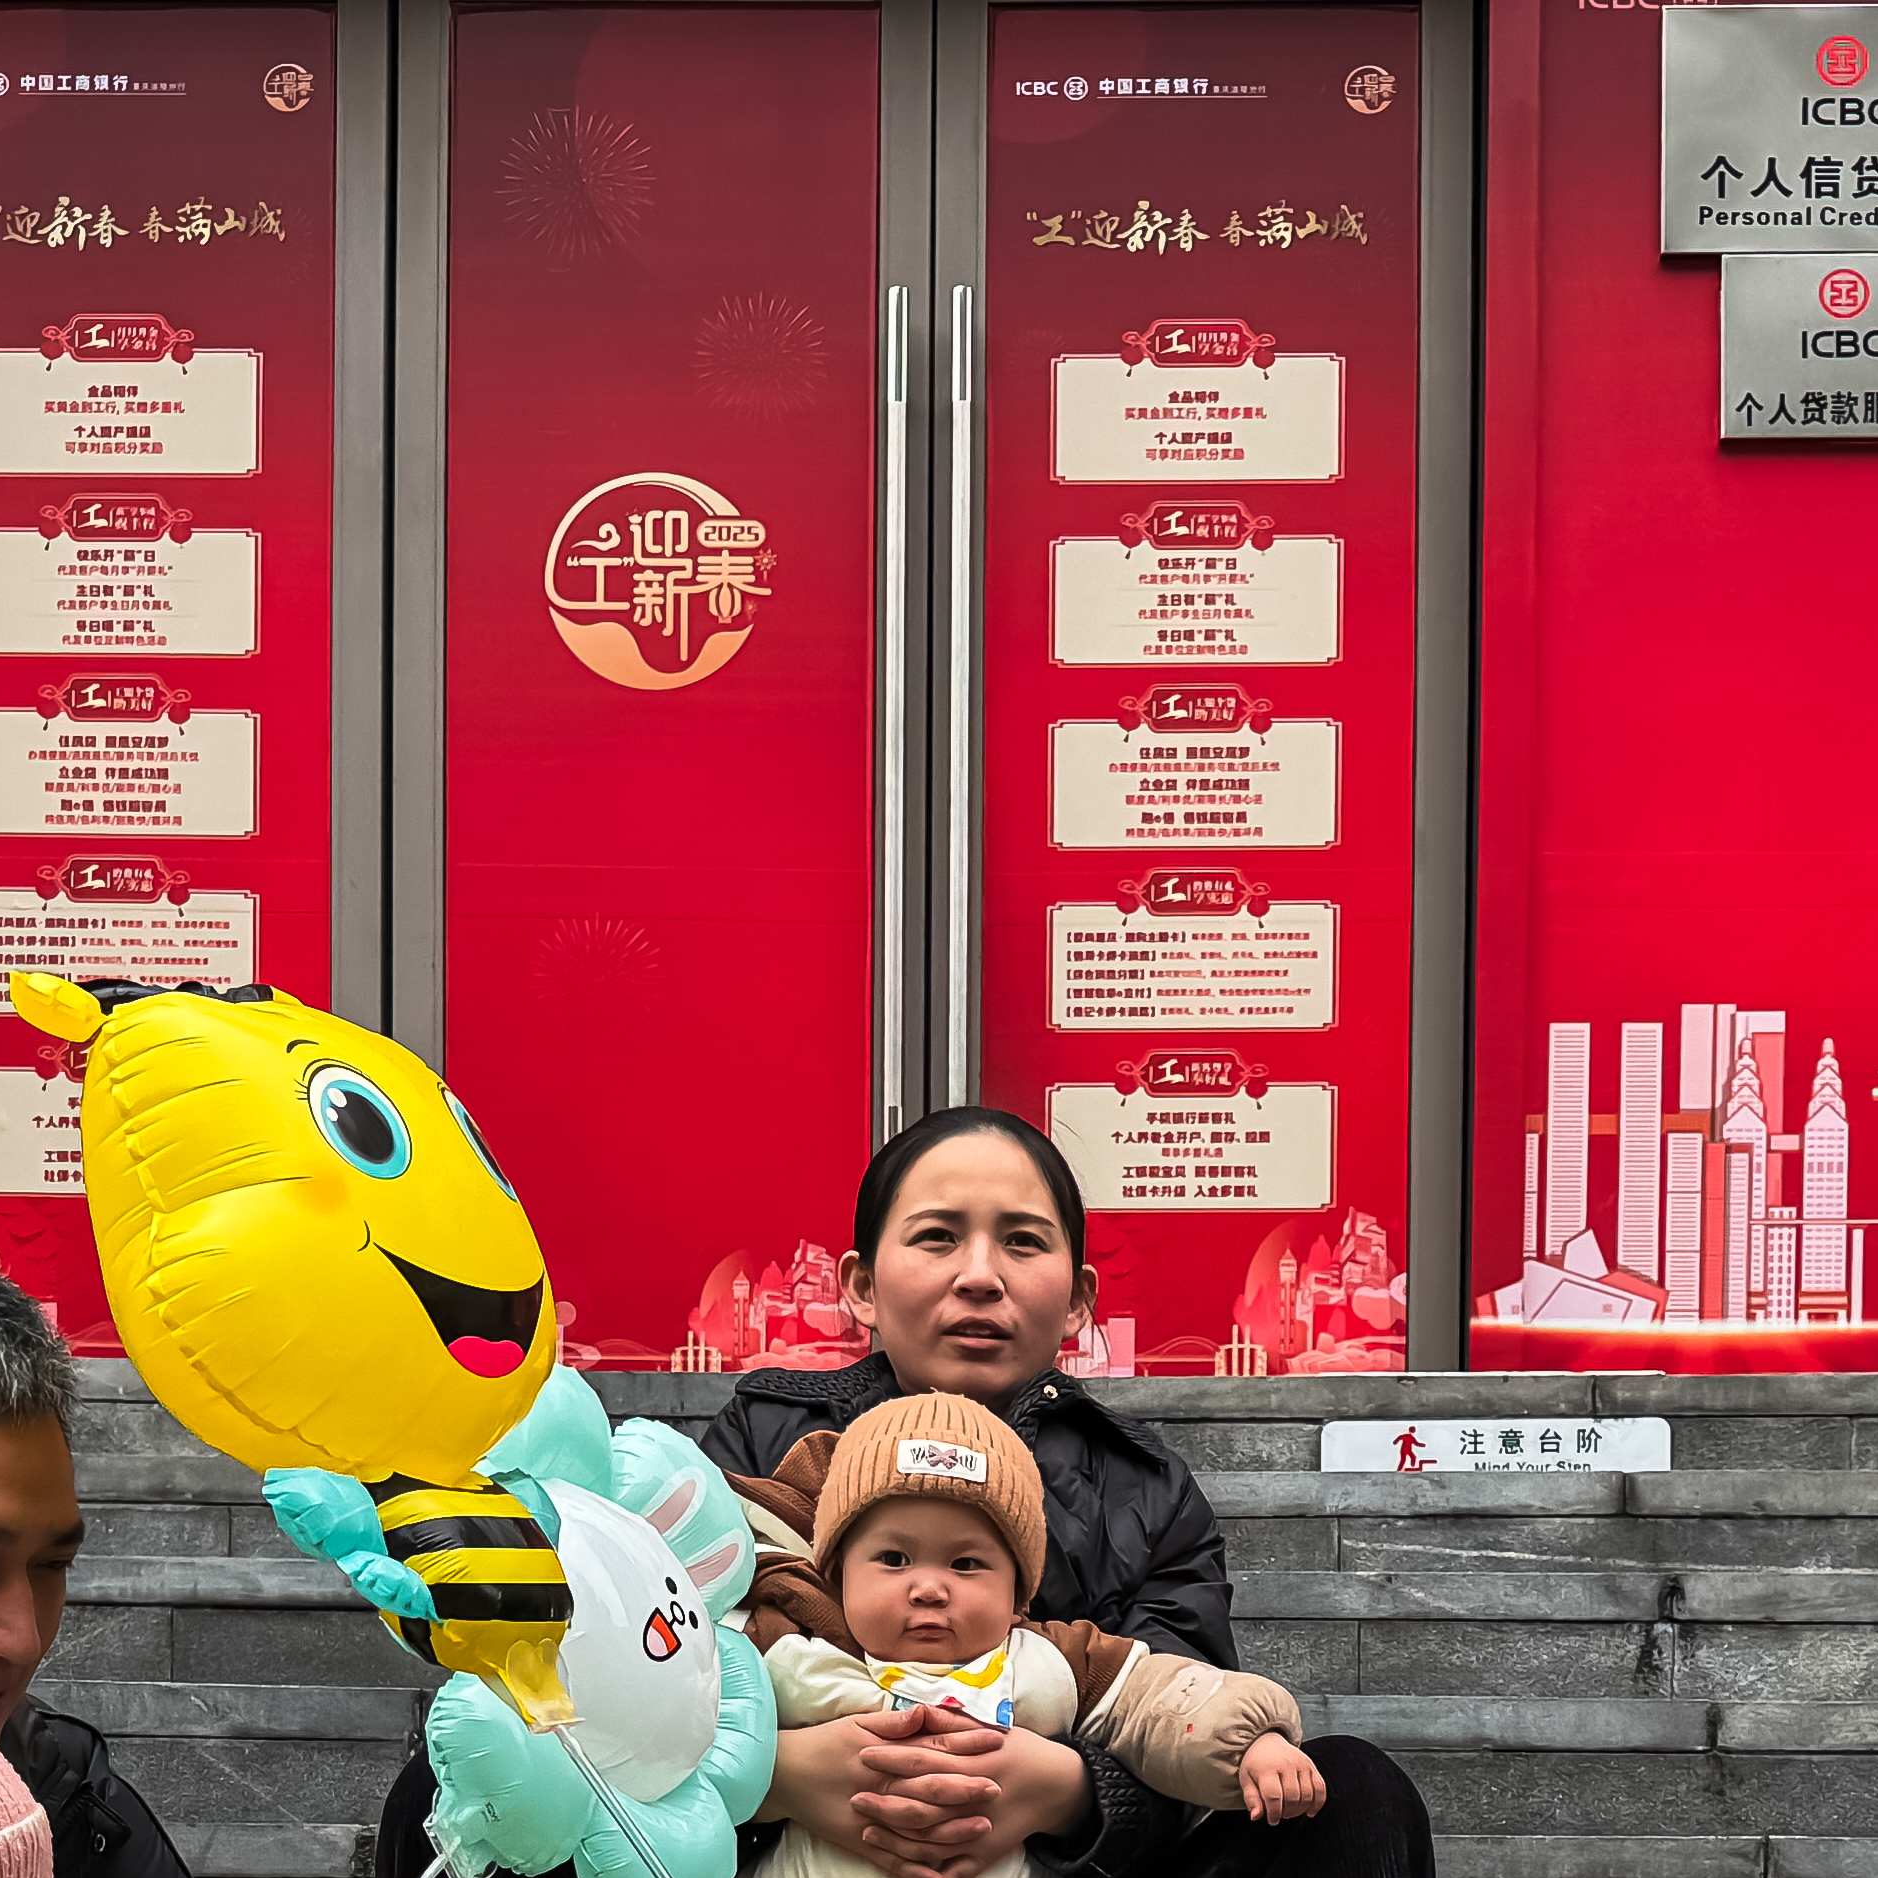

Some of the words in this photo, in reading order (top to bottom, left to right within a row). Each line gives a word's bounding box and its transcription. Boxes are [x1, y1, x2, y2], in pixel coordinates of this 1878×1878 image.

[20, 74, 128, 92] 中国工商银行
[1015, 81, 1059, 96] ICBC
[1098, 78, 1209, 95] 中国工商银行
[138, 196, 287, 246] 春满山城
[1218, 200, 1369, 249] 春满山城
[1698, 206, 1812, 227] Personal
[703, 525, 760, 542] 2025
[1459, 1427, 1603, 1455] 注意台阶
[1474, 1461, 1511, 1472] Mind
[1517, 1461, 1551, 1472] Your
